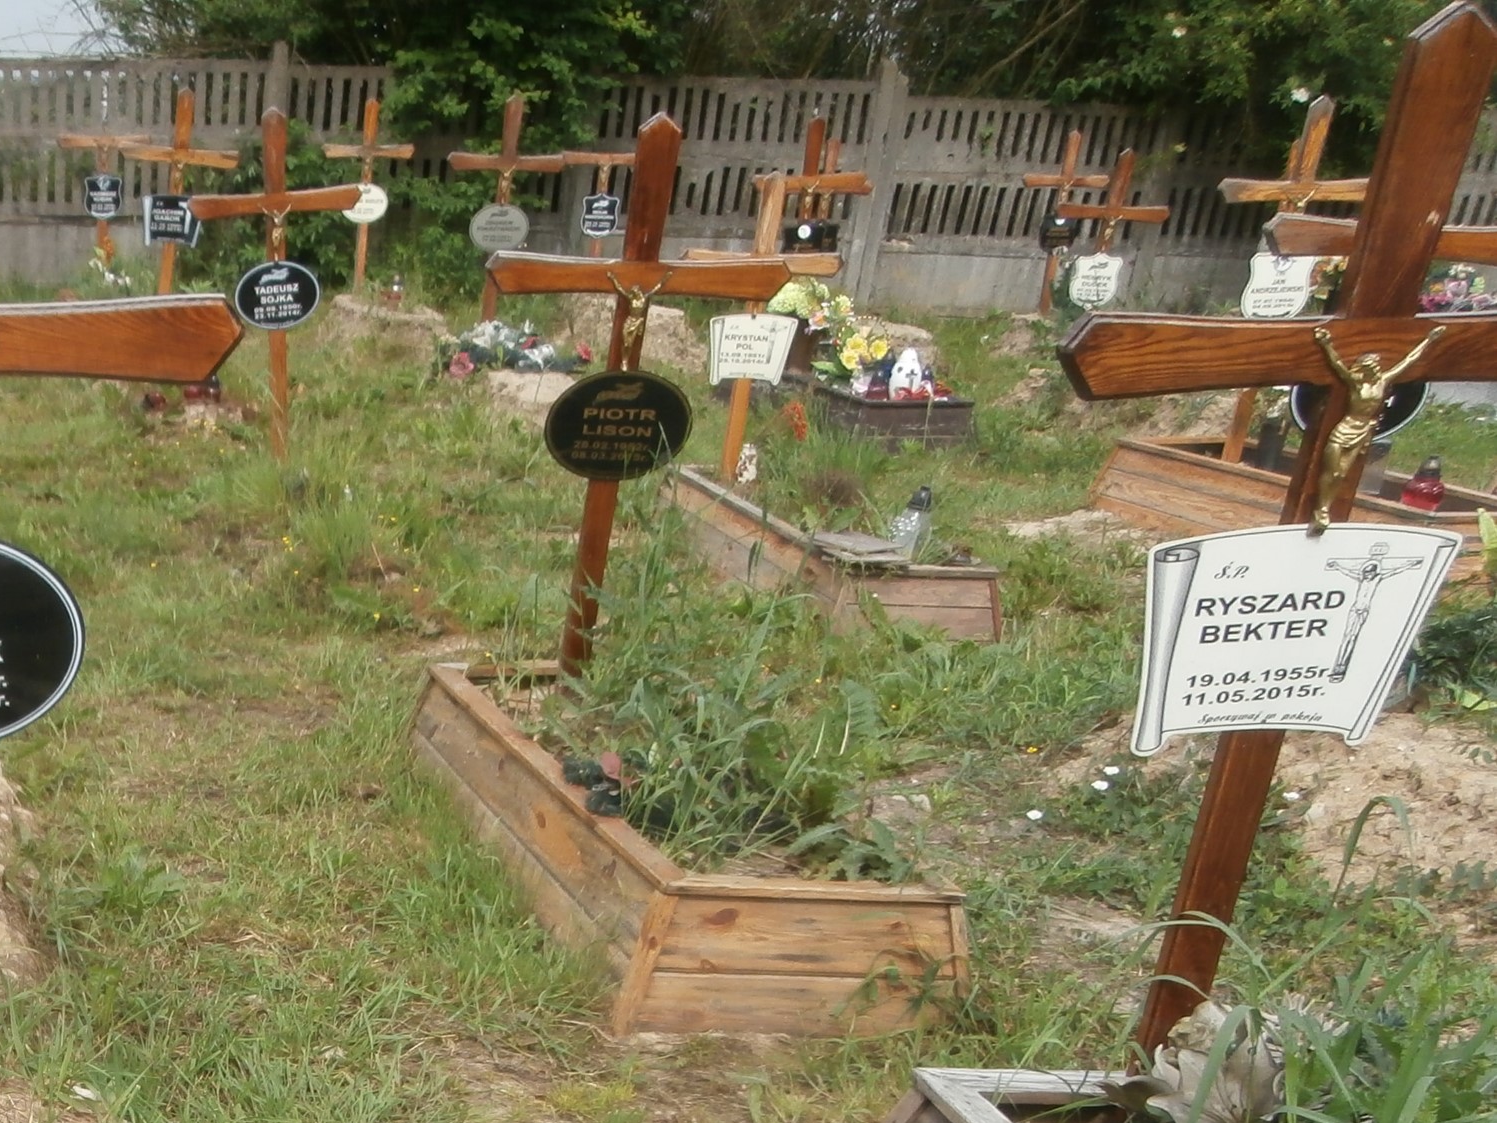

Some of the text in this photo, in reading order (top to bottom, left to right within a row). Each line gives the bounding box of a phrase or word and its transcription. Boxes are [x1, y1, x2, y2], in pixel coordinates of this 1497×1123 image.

[254, 283, 299, 295] TADEUSZ
[260, 294, 294, 305] SOJKA
[724, 334, 769, 342] KRYSTIAN
[735, 343, 754, 351] POL
[583, 407, 657, 422] PIOTR
[582, 424, 653, 438] LISON
[1213, 561, 1251, 580] Ś.P.
[1194, 590, 1346, 617] RYSZARD
[1199, 618, 1329, 644] BEKTER
[1181, 683, 1326, 707] 11.05.2015r.
[1197, 709, 1263, 725] Spoczywaj
[1279, 710, 1323, 723] pokoju
